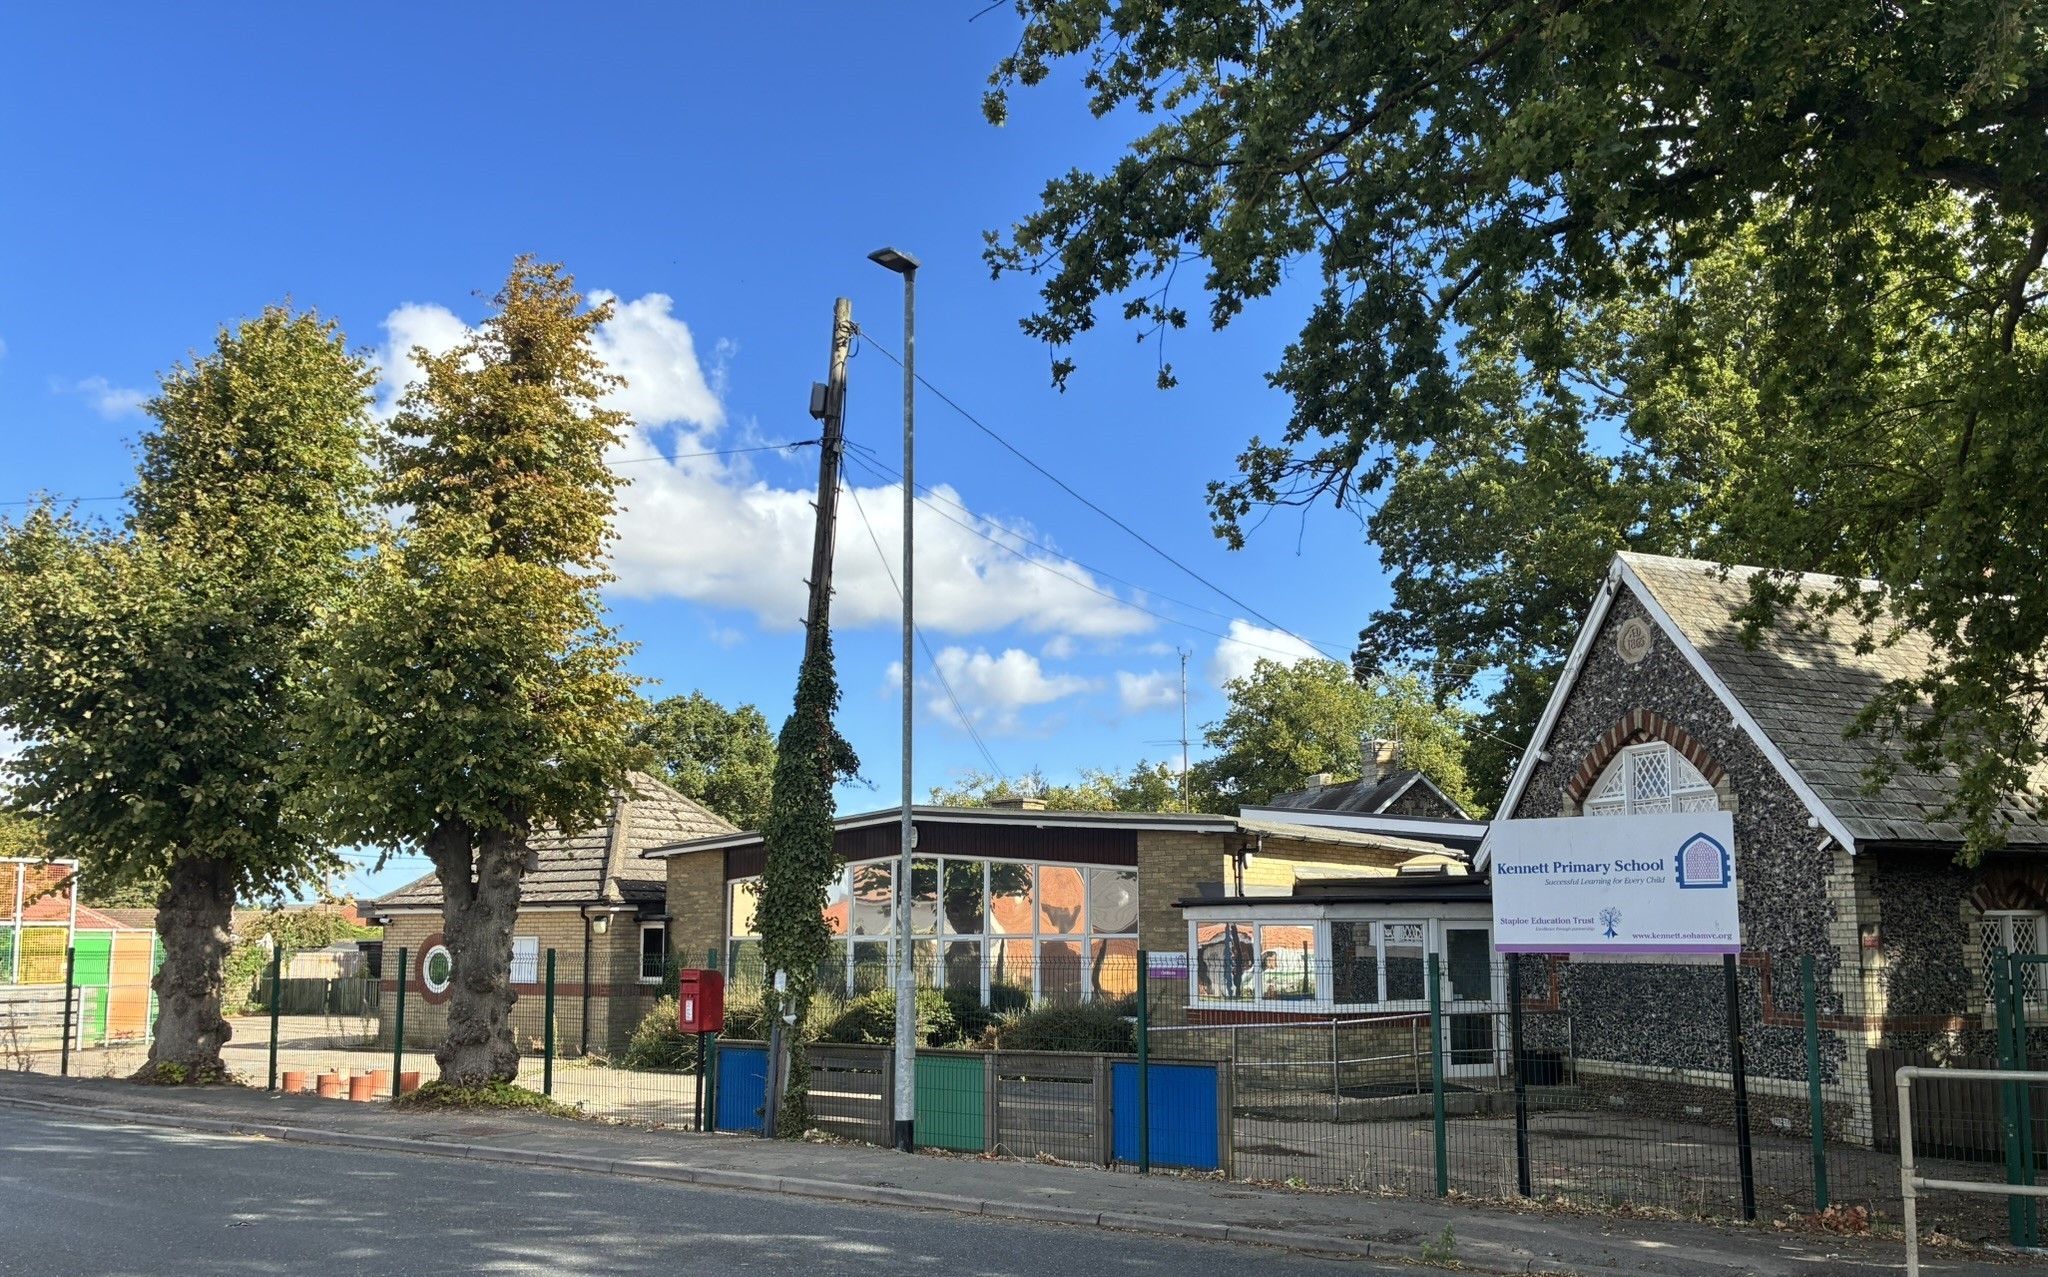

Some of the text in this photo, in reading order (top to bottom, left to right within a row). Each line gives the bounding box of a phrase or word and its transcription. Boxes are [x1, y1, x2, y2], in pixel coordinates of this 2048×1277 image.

[1498, 859, 1664, 875] Kennett Primary School
[1580, 878, 1611, 886] Learning
[1624, 877, 1644, 885] Every
[1500, 918, 1529, 926] Staploe
[1632, 932, 1732, 940] www.kennett.sohamvc.org
